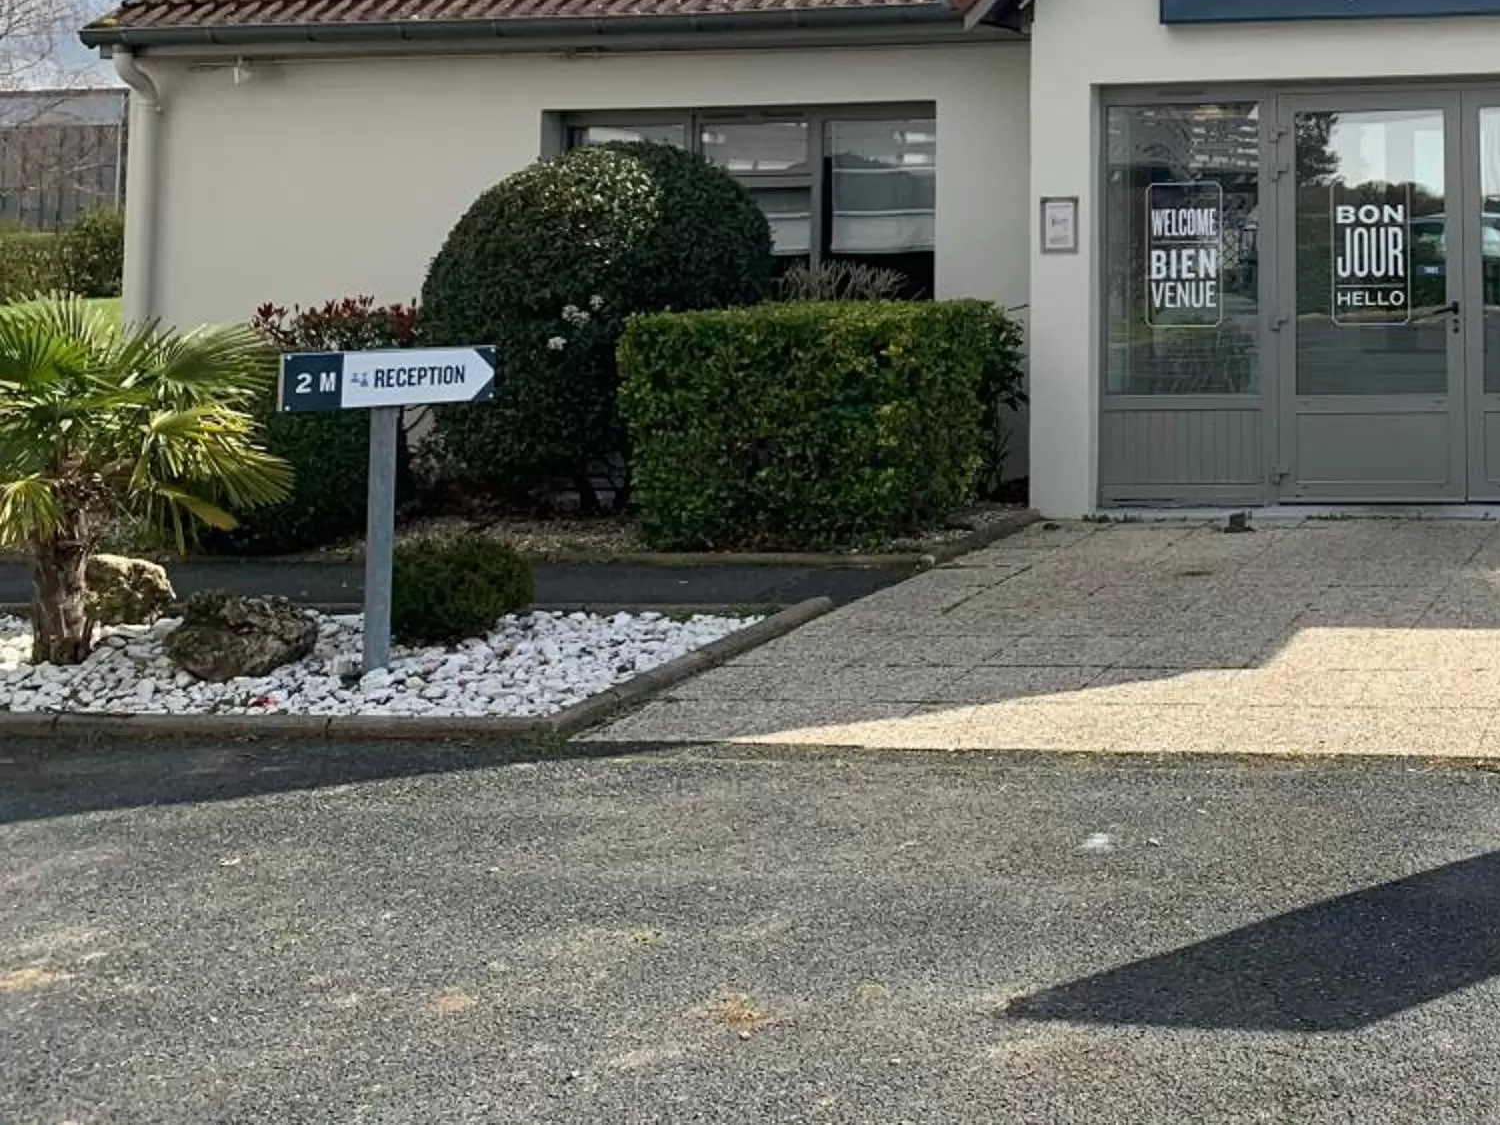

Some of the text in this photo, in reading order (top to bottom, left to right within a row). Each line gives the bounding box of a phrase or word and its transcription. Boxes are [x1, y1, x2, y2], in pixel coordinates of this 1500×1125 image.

[1151, 207, 1217, 237] WELCOME
[1335, 204, 1405, 224] BON
[1151, 248, 1217, 280] BIEN
[1336, 226, 1404, 277] JOUR
[1151, 280, 1217, 309] VENUE
[1336, 290, 1405, 307] HELLO
[295, 372, 336, 394] 2 M
[374, 365, 466, 388] RECEPTION
